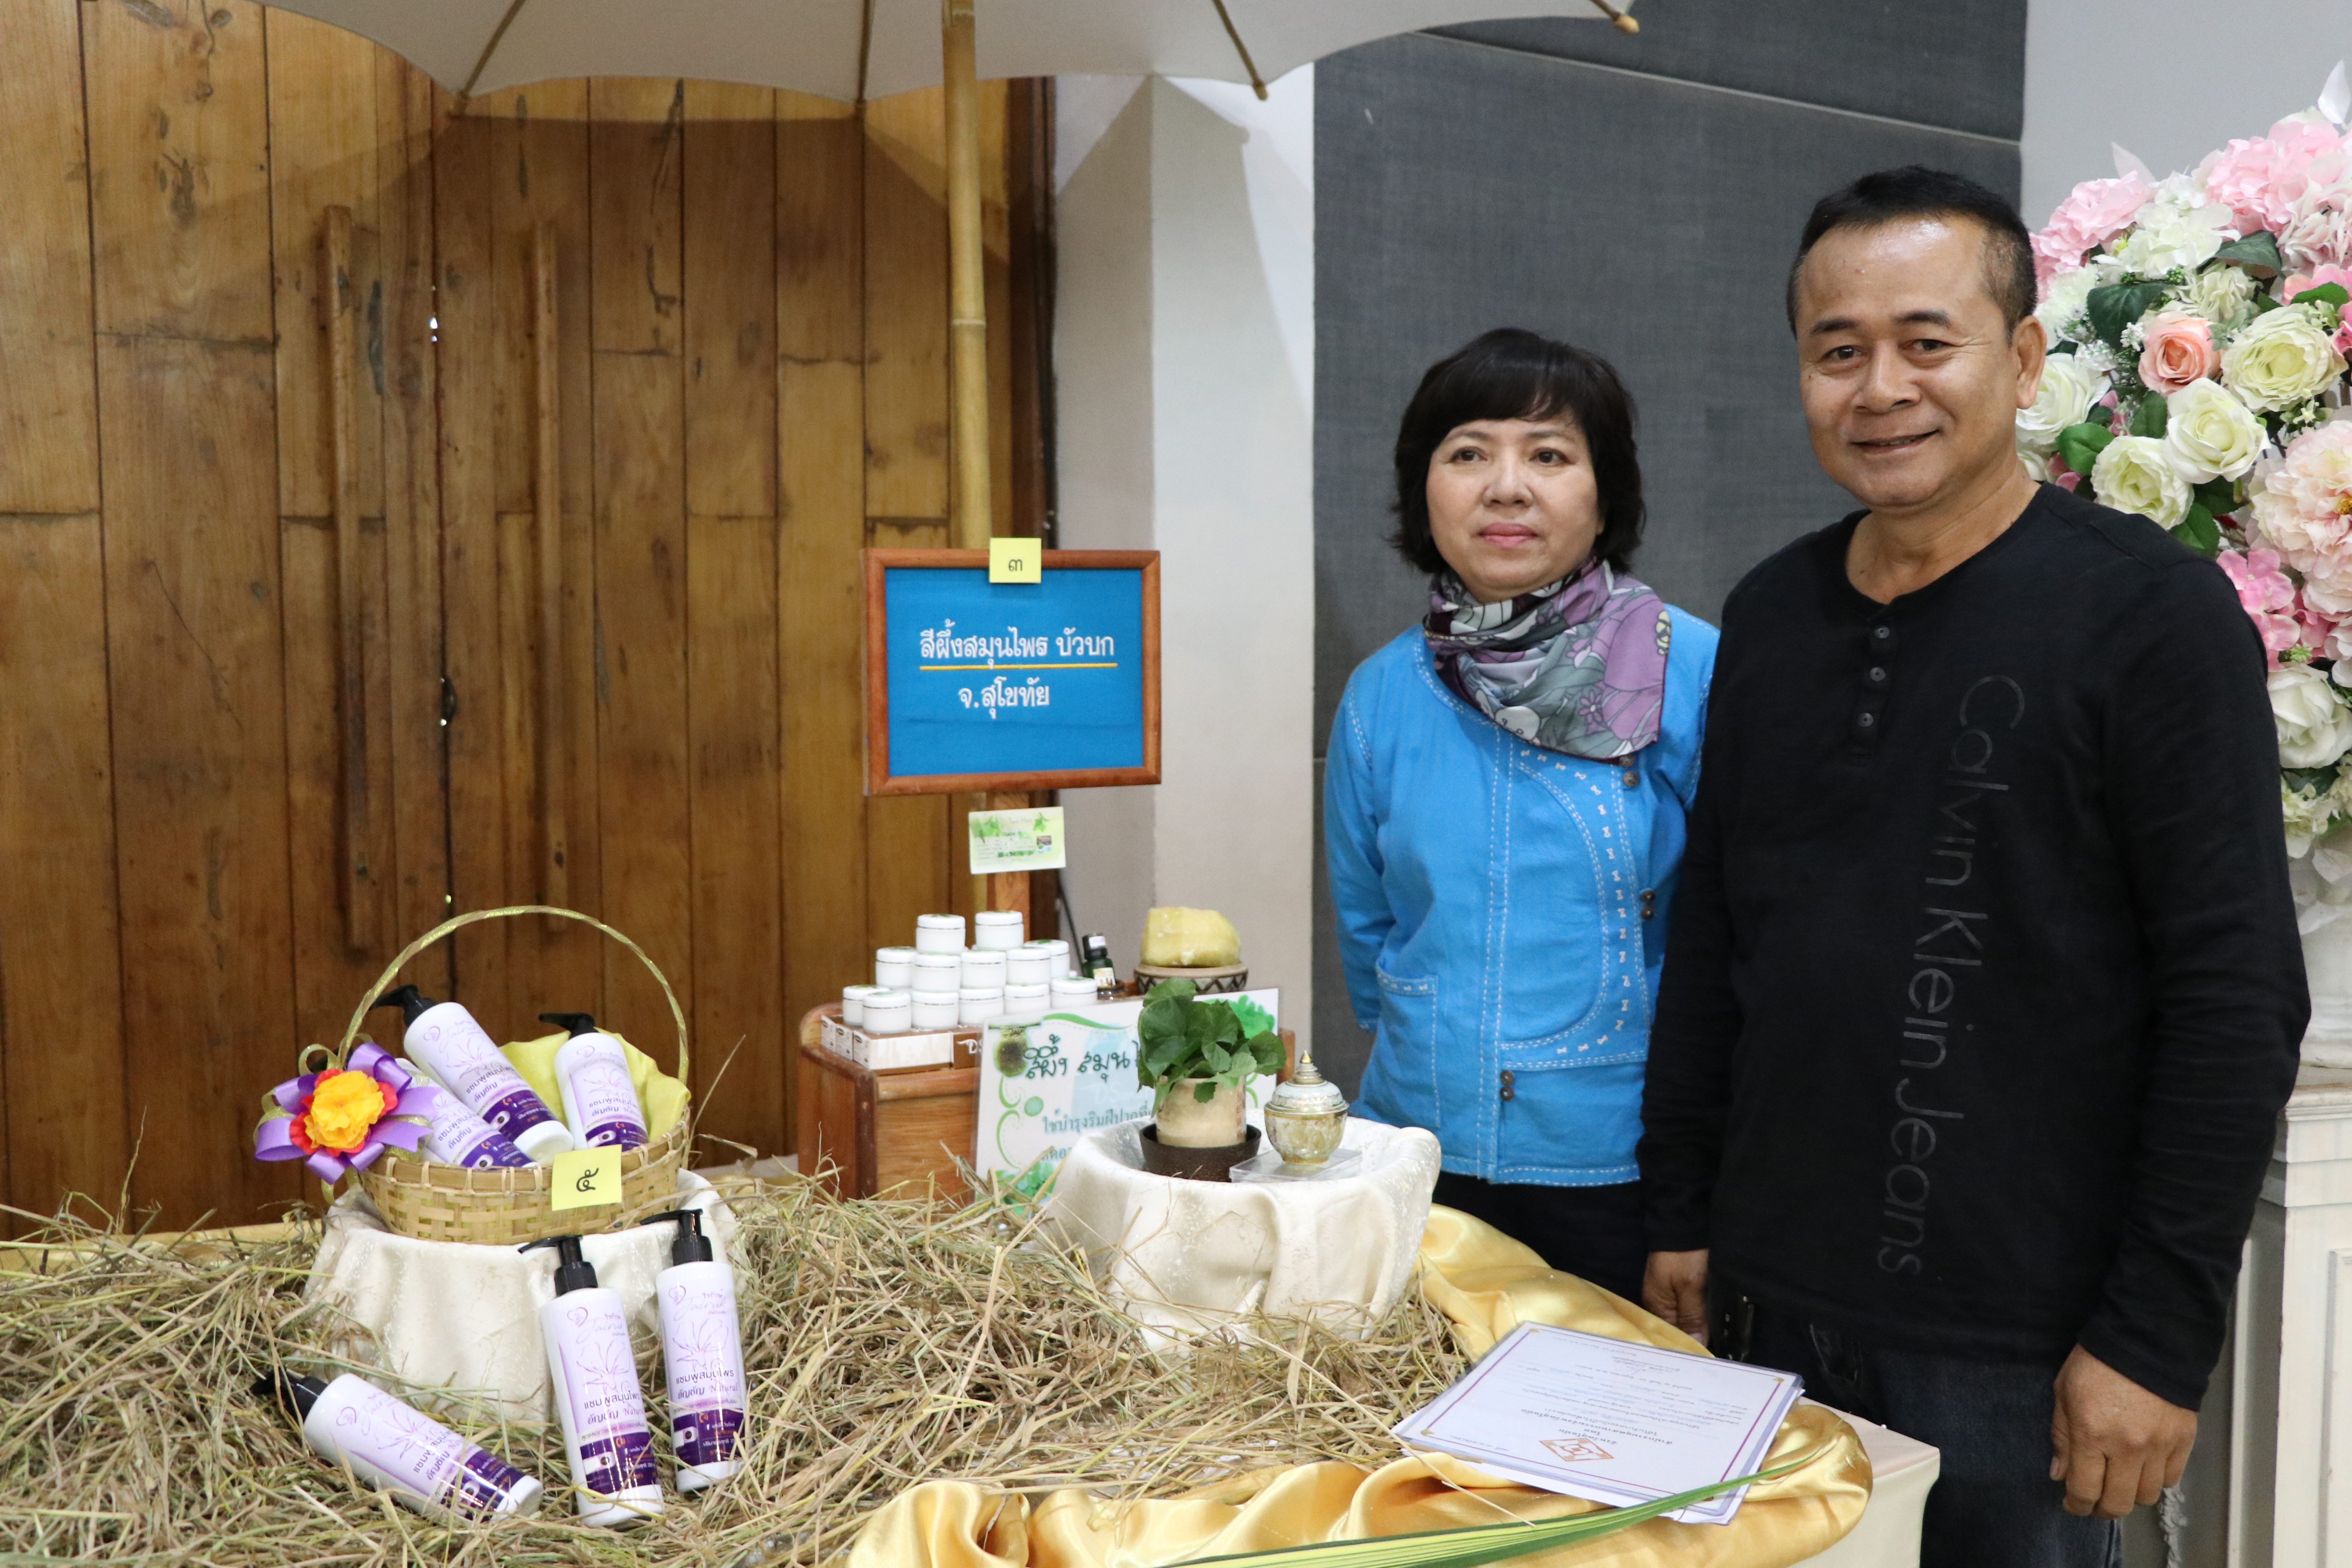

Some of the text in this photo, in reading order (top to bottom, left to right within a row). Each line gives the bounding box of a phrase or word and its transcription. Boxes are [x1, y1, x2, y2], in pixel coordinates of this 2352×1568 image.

[1008, 559, 1023, 571] ๓
[920, 618, 1114, 670] สีผึ้งสมุนไพร บัวบก
[958, 676, 1050, 719] จ.สุโขทัย
[1876, 673, 2027, 1277] Calvin Klein Jeans
[576, 1167, 599, 1192] ๕
[678, 1385, 705, 1399] อัญชัญ
